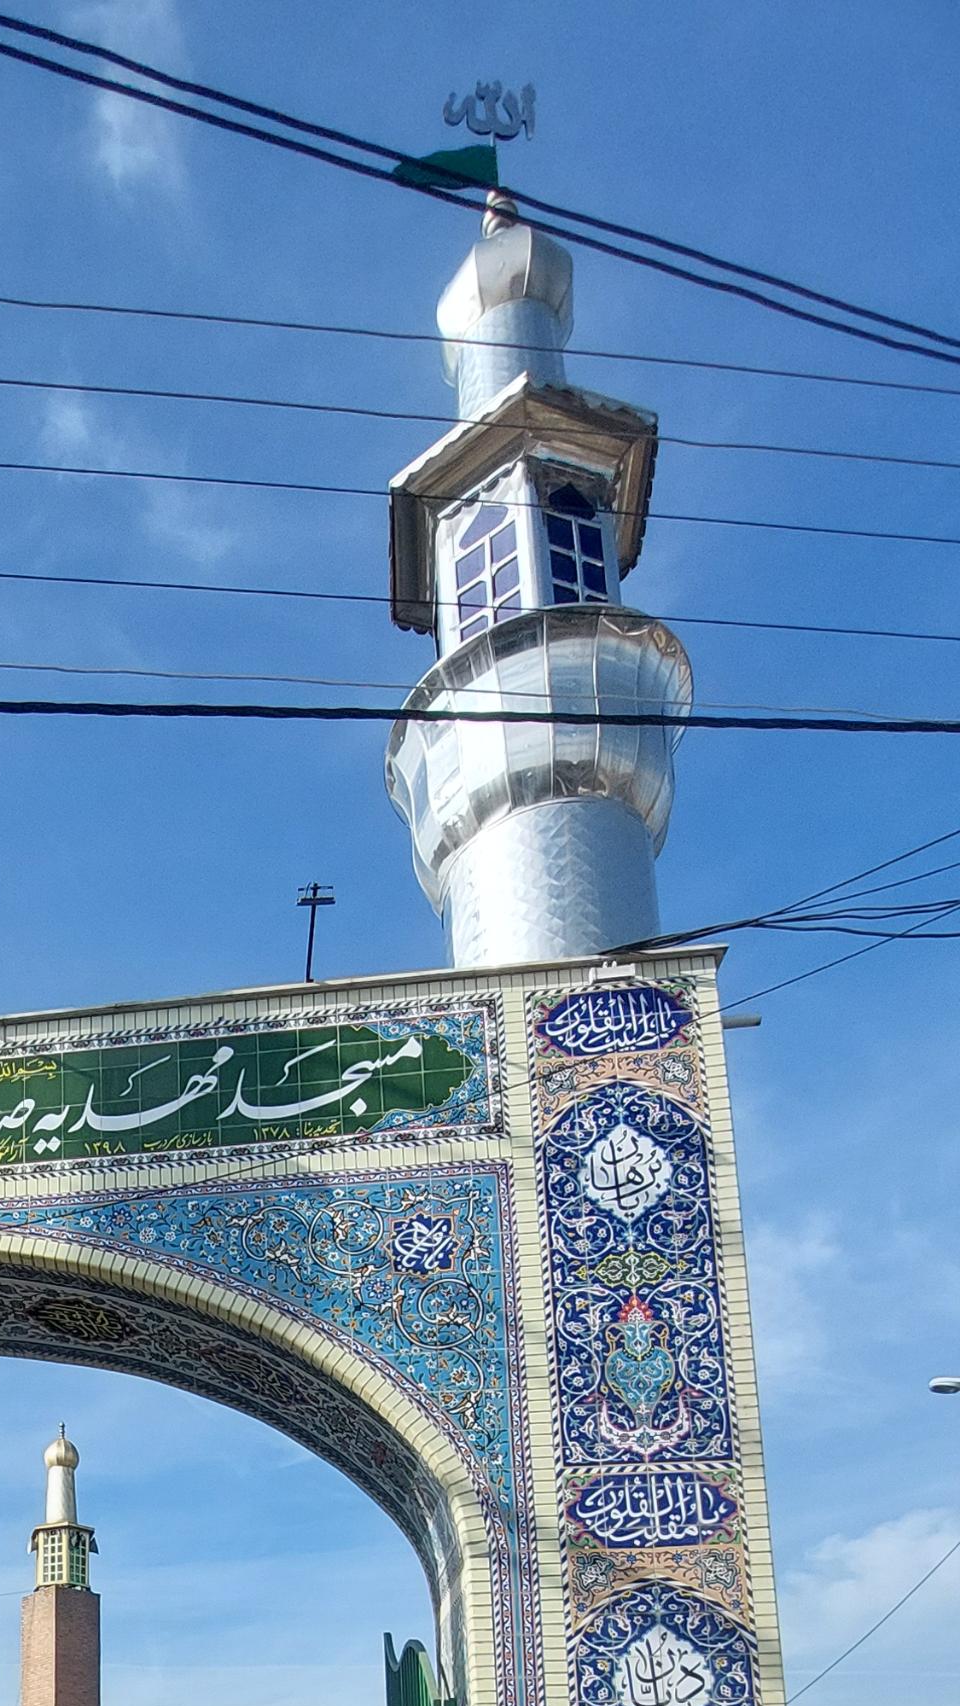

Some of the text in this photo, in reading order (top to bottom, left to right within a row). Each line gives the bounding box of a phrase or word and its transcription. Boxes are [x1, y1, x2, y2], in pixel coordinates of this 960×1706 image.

[216, 1036, 424, 1119] مسجد
[253, 1127, 290, 1141] ۱۳۷۸
[84, 1140, 126, 1155] ۱۳۹۸
